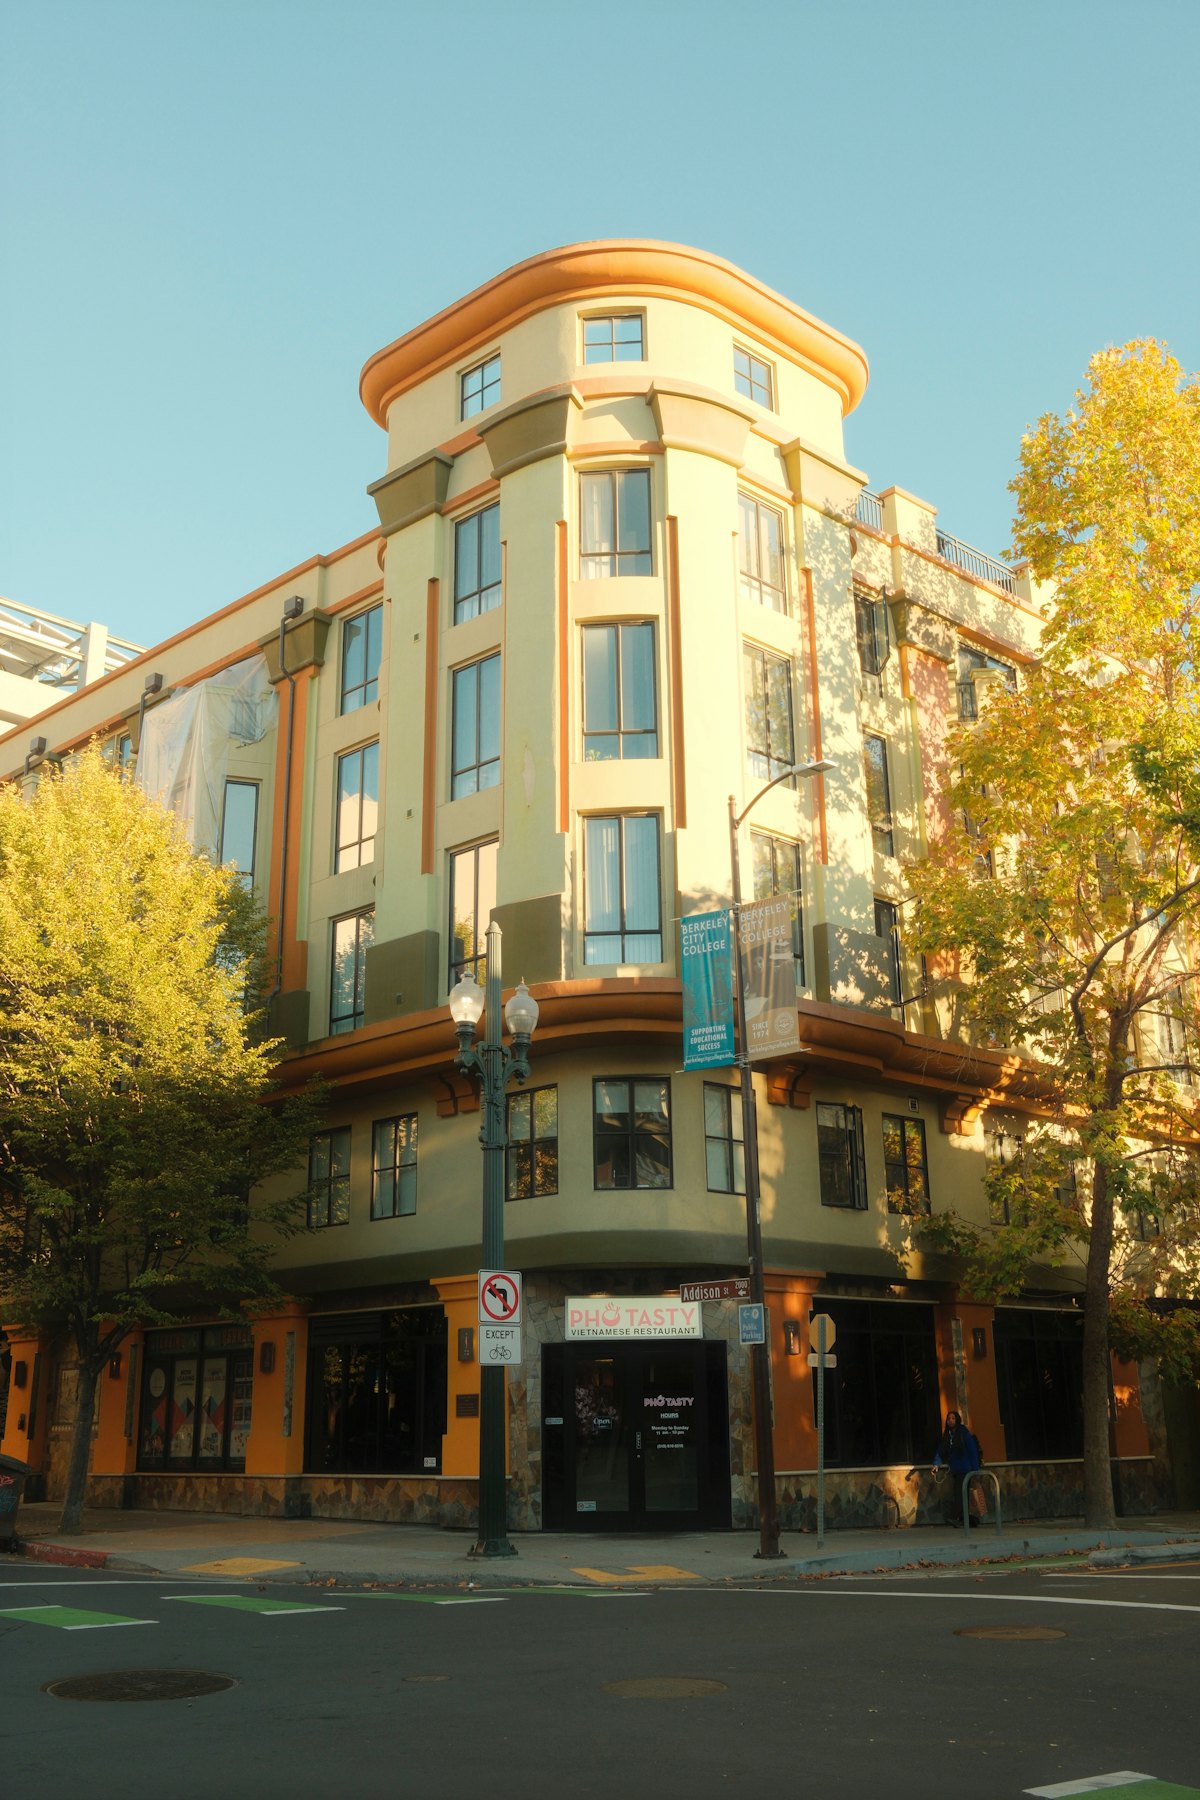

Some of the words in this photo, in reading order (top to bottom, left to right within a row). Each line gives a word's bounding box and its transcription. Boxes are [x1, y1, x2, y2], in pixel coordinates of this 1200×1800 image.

[740, 902, 788, 922] BERKELEY
[682, 917, 729, 935] BERKELEY
[741, 919, 764, 933] CITY
[682, 933, 705, 945] CITY
[741, 925, 786, 944] COLLEGE
[682, 939, 726, 956] COLLEGE
[691, 1024, 727, 1036] SUPPORTING
[751, 1021, 769, 1030] SINCE
[690, 1033, 727, 1045] EDUCATIONAL
[752, 1029, 769, 1039] 1974
[697, 1042, 721, 1052] SUCCESS
[735, 1281, 748, 1290] 2000
[683, 1285, 721, 1301] Addison
[723, 1287, 729, 1295] St
[570, 1303, 621, 1327] PHO
[625, 1308, 696, 1327] TASTY
[485, 1330, 515, 1339] EXCEPT
[571, 1328, 631, 1336] VIETNAMESE
[634, 1327, 697, 1335] RESTAURANT
[643, 1395, 665, 1407] PHO
[665, 1397, 695, 1407] TASTY
